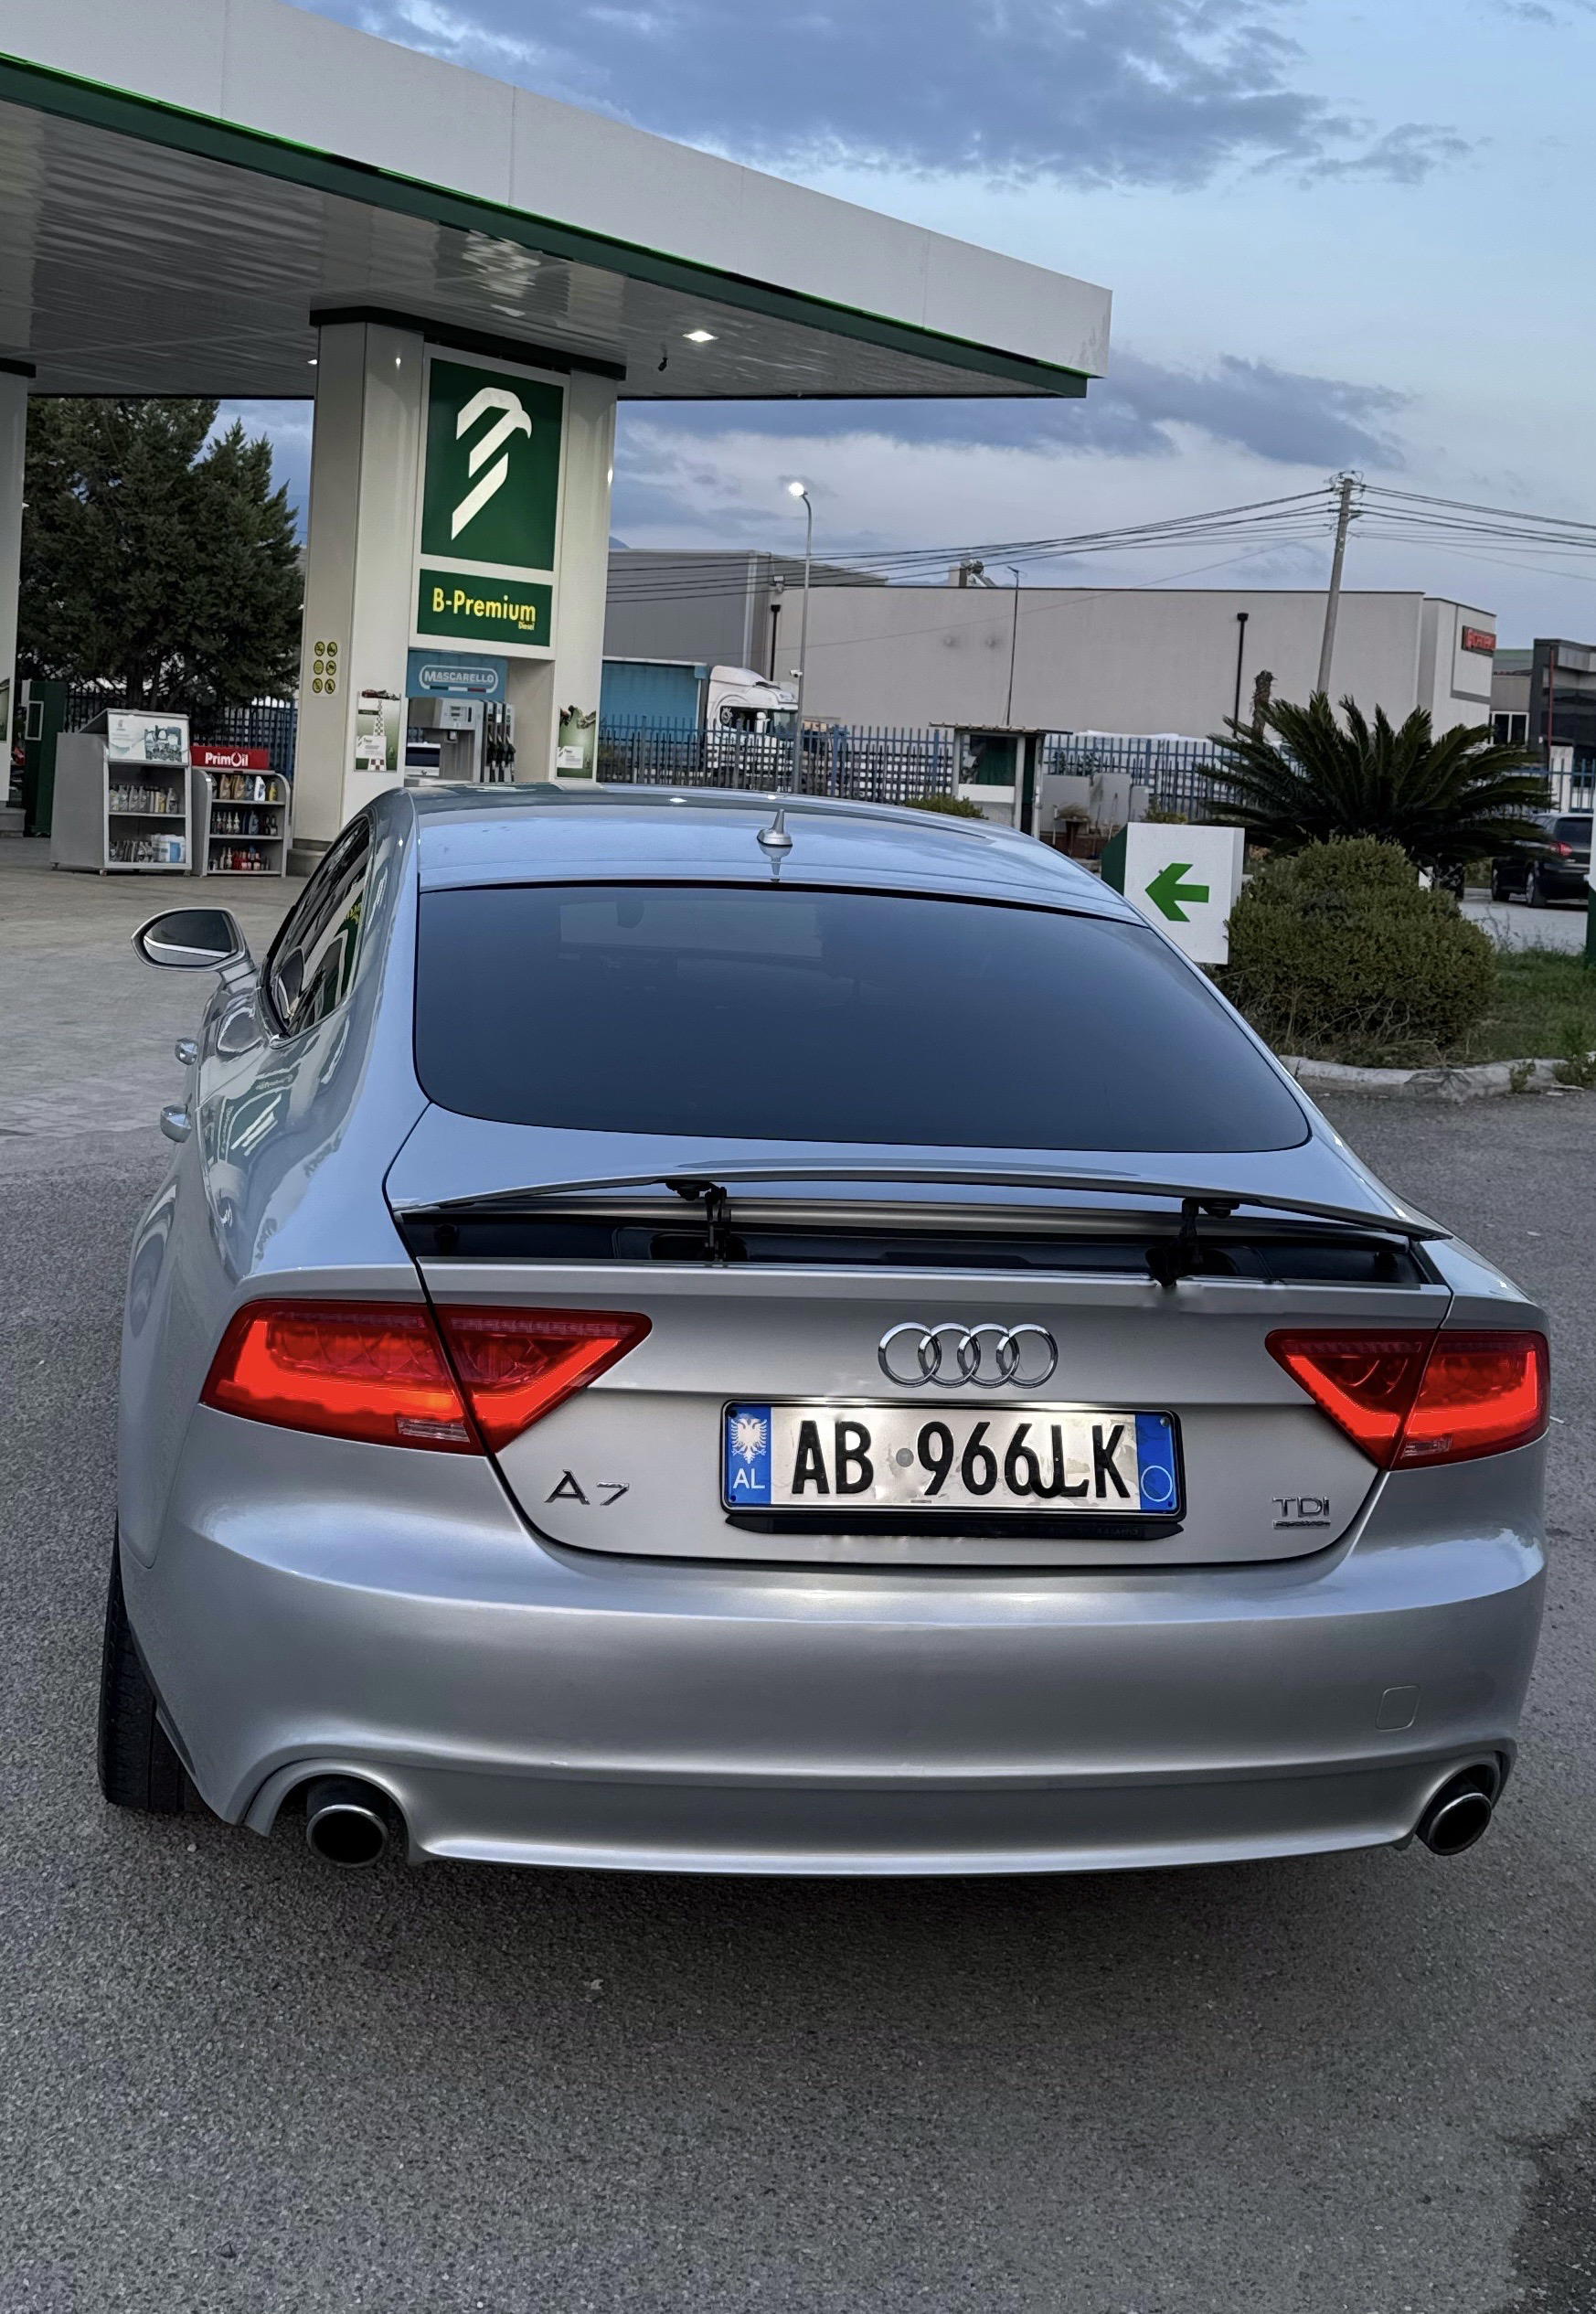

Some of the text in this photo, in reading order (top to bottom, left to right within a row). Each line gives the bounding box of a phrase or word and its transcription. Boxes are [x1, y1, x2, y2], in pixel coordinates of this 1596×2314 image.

[432, 587, 536, 623] B-Premium
[205, 751, 249, 767] PrimOil
[792, 1420, 874, 1495] AB
[733, 1469, 765, 1489] AL
[1272, 1496, 1330, 1519] TDI
